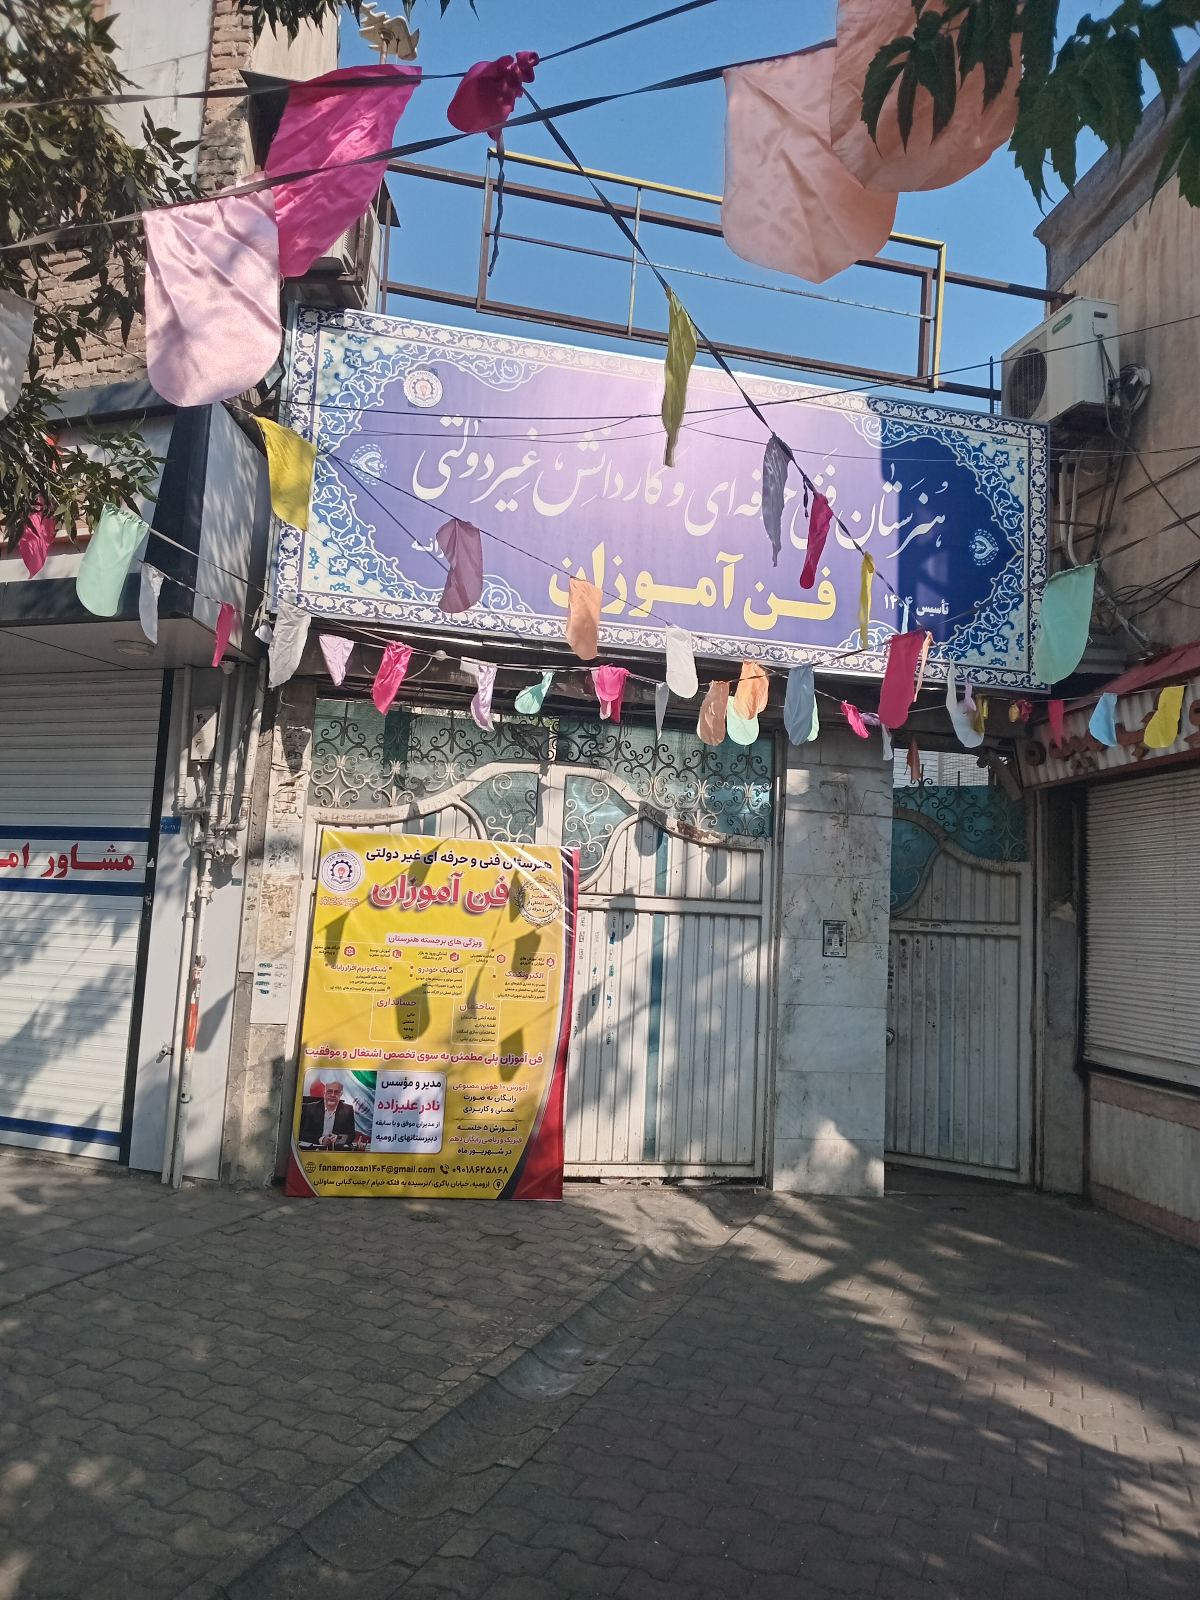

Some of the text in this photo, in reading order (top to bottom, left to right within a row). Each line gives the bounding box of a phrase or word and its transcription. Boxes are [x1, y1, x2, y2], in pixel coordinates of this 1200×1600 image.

[548, 541, 837, 630] فن آموزان
[40, 842, 135, 878] مشاور
[366, 848, 552, 872] هنرستان فنی و حرفه ای غیر دولتی
[371, 870, 510, 913] فن آموزان
[388, 934, 482, 948] ویژگی های برجسته هنرستان
[417, 966, 464, 975] مکانیک خودرو
[376, 997, 417, 1008] حسابداری
[459, 1001, 496, 1013] ساختمان
[305, 1045, 543, 1066] فن آموزان پلی مطمئن به سوی تخصص اشتغال و موفقیت
[381, 1076, 442, 1090] مدیر و مؤسس
[452, 1083, 479, 1091] مصنوعی
[480, 1083, 499, 1092] هوش
[463, 1094, 486, 1102] صورت
[494, 1093, 517, 1103] رایگان
[377, 1099, 441, 1114] نادر علیزاده
[463, 1105, 490, 1114] کاربردی
[495, 1106, 515, 1114] عملی
[400, 1120, 415, 1128] موفق
[457, 1124, 482, 1132] جلسه
[489, 1123, 518, 1133] آموزش
[375, 1133, 397, 1142] ارومیه
[457, 1146, 468, 1155] ماه
[469, 1147, 504, 1156] شهریور
[370, 1179, 385, 1187] خیام
[450, 1180, 469, 1188] خیابان
